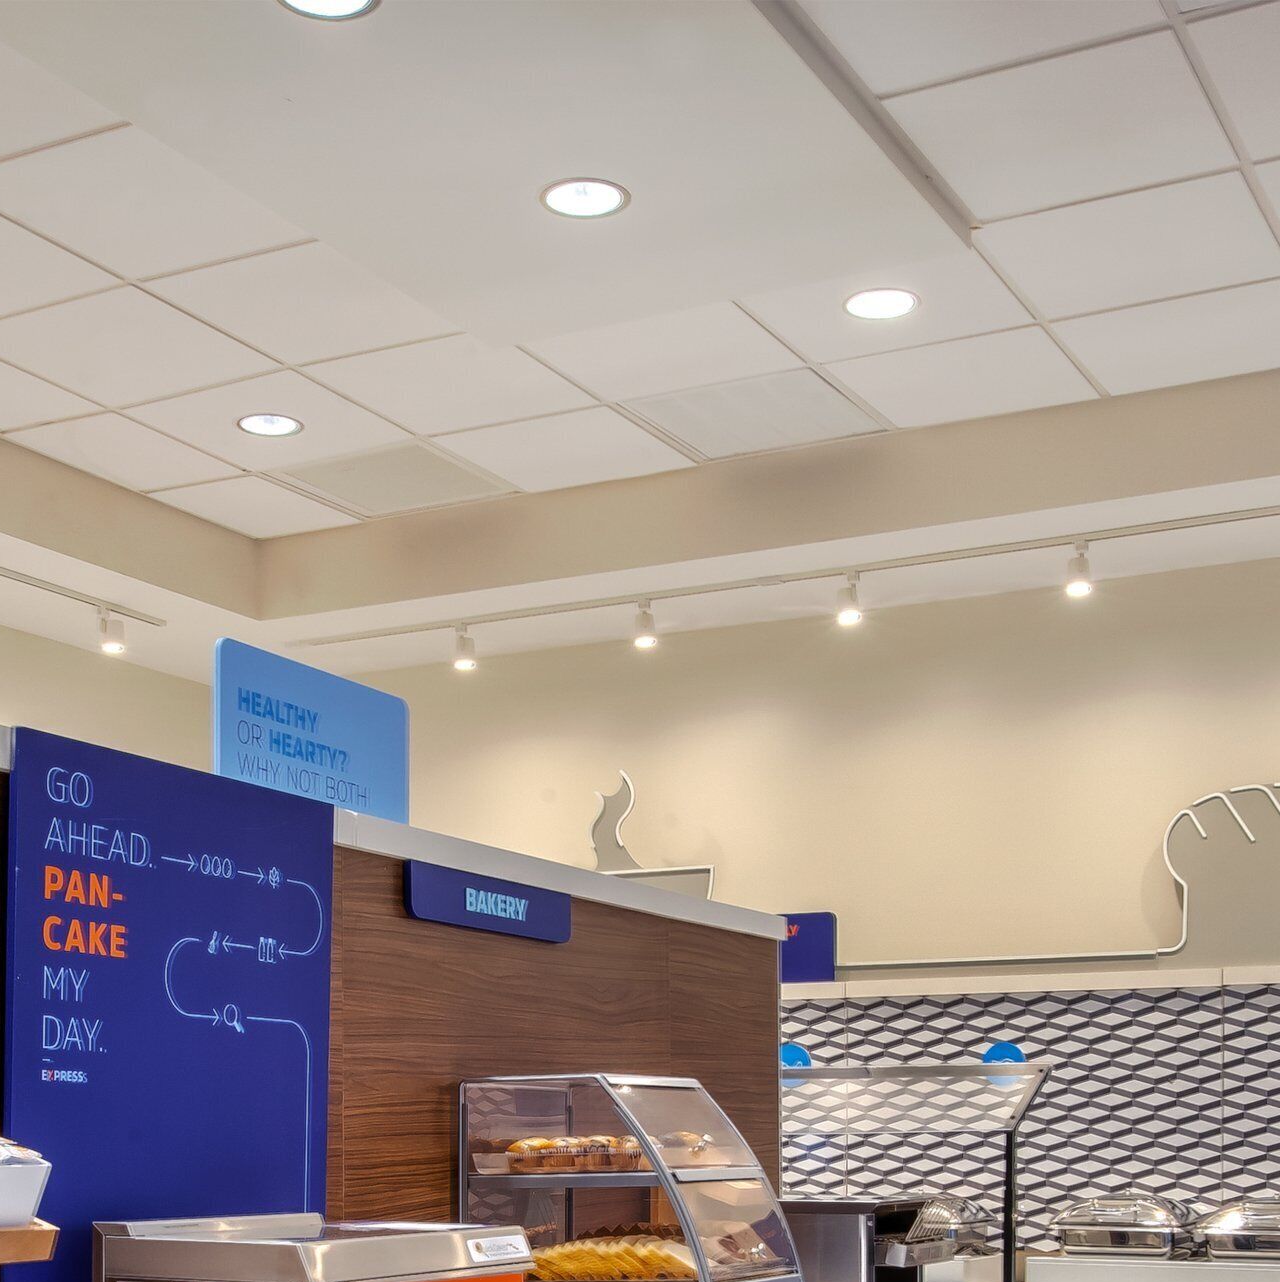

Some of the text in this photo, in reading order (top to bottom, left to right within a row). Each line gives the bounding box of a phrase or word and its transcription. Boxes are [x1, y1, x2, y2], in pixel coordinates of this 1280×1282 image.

[237, 687, 320, 733] HEALTHY
[237, 720, 348, 772] OR HEARTY?
[46, 767, 93, 807] GO
[237, 752, 280, 785] WHY
[287, 765, 320, 796] NOT
[44, 817, 155, 869] AHEAD.
[44, 865, 125, 908] PAN-
[465, 887, 528, 921] BAKERY
[42, 915, 128, 958] CAKE
[43, 965, 89, 1002] MY
[42, 1015, 105, 1053] DAY.
